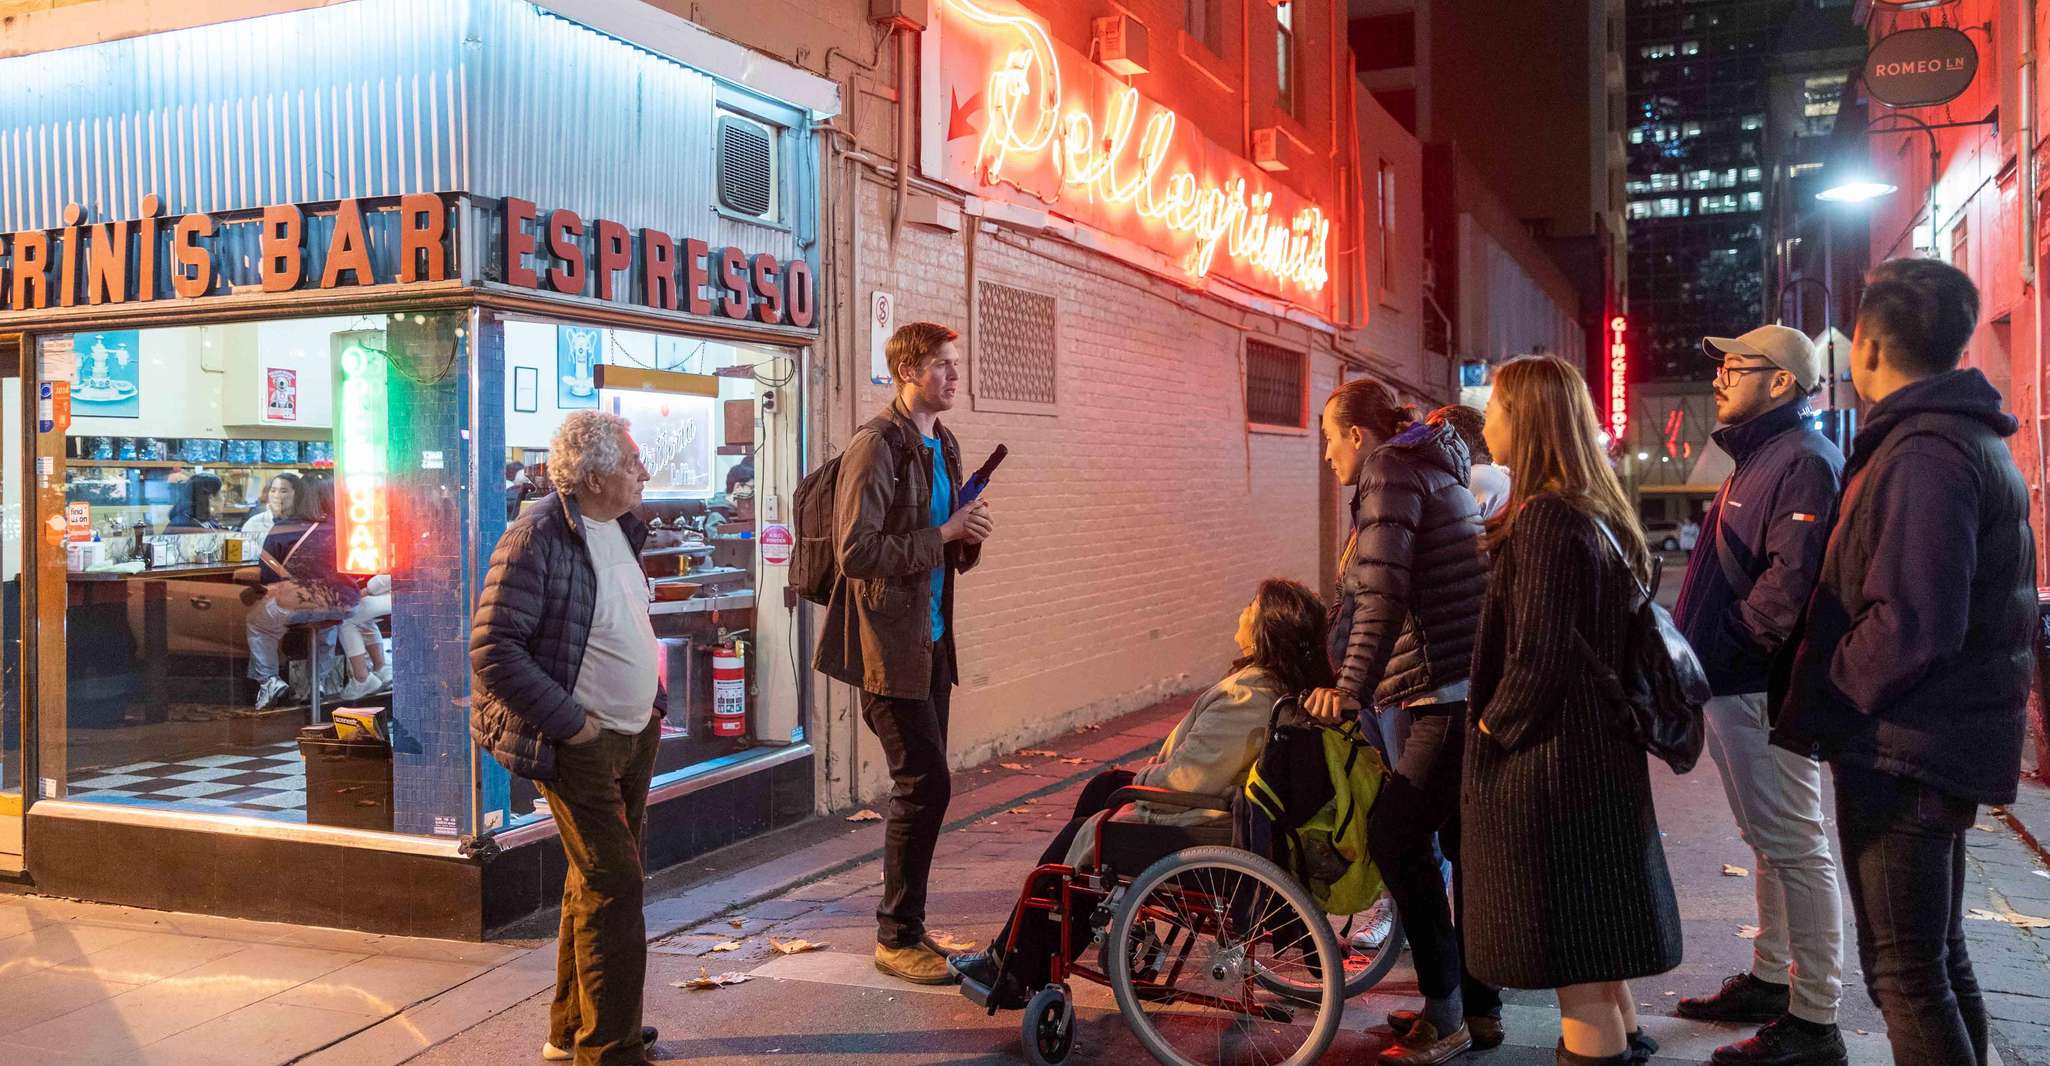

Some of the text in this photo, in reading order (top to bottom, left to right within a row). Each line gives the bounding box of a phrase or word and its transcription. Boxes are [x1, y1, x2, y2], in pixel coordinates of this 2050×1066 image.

[1875, 57, 1965, 77] ROMEO LN
[262, 193, 449, 293] BAR
[501, 196, 815, 328] ESPRESSO
[1611, 316, 1628, 439] GINGERBOY
